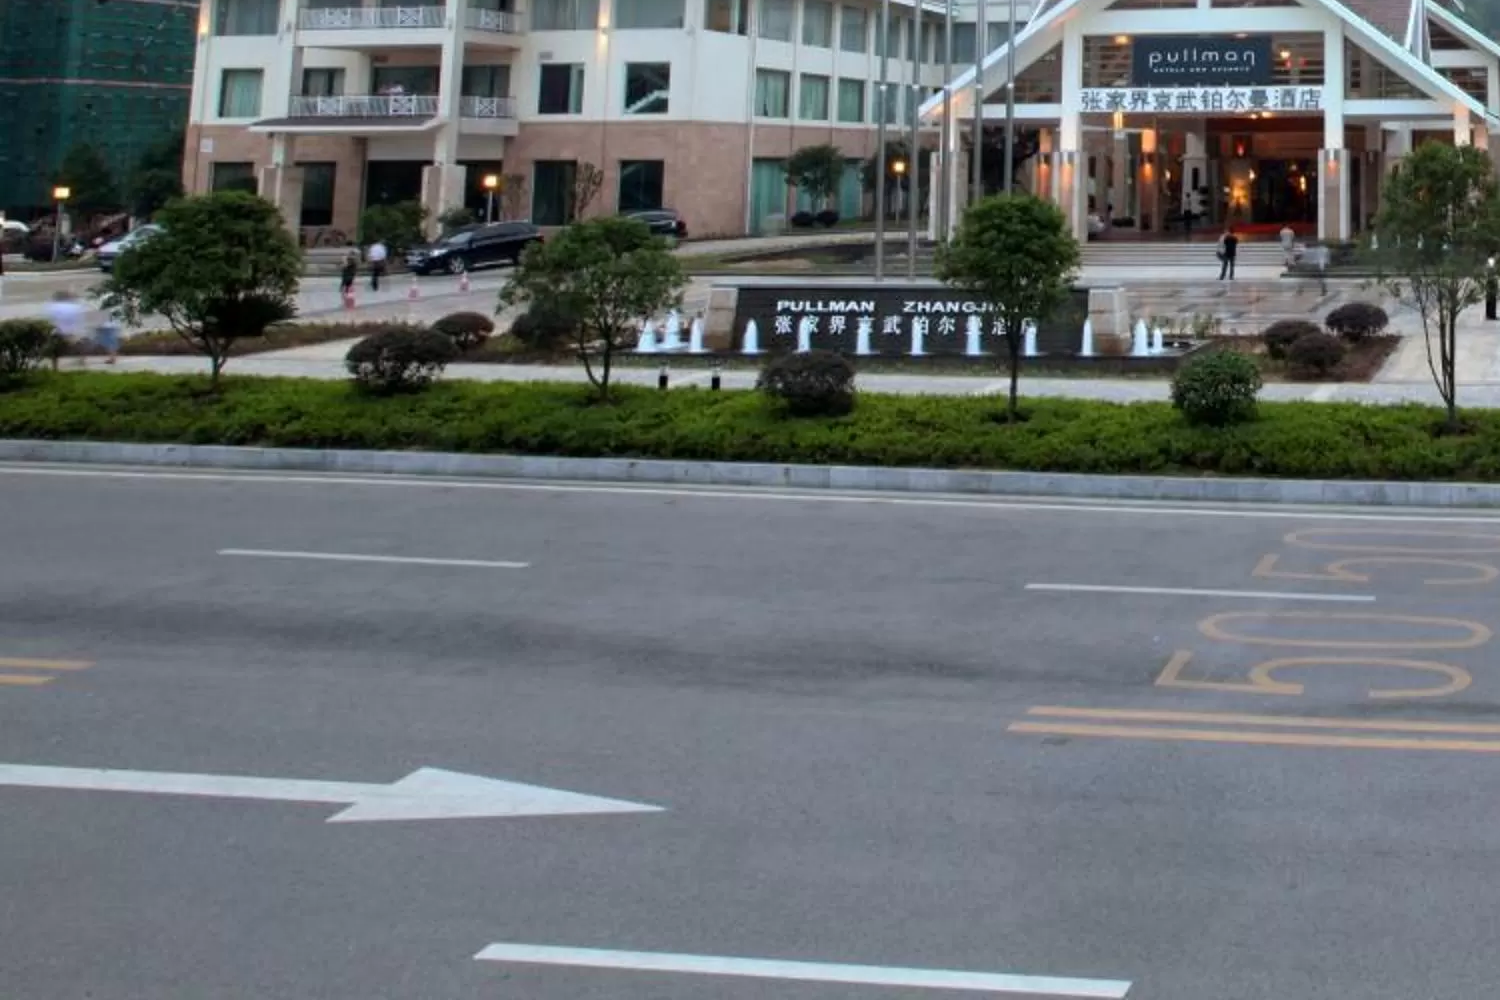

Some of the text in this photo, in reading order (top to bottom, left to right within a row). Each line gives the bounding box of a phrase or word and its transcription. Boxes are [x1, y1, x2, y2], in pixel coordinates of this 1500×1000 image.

[1148, 47, 1255, 68] pullman
[776, 300, 1041, 313] PULLMAN ZHANGJIA
[1155, 610, 1492, 698] 50
